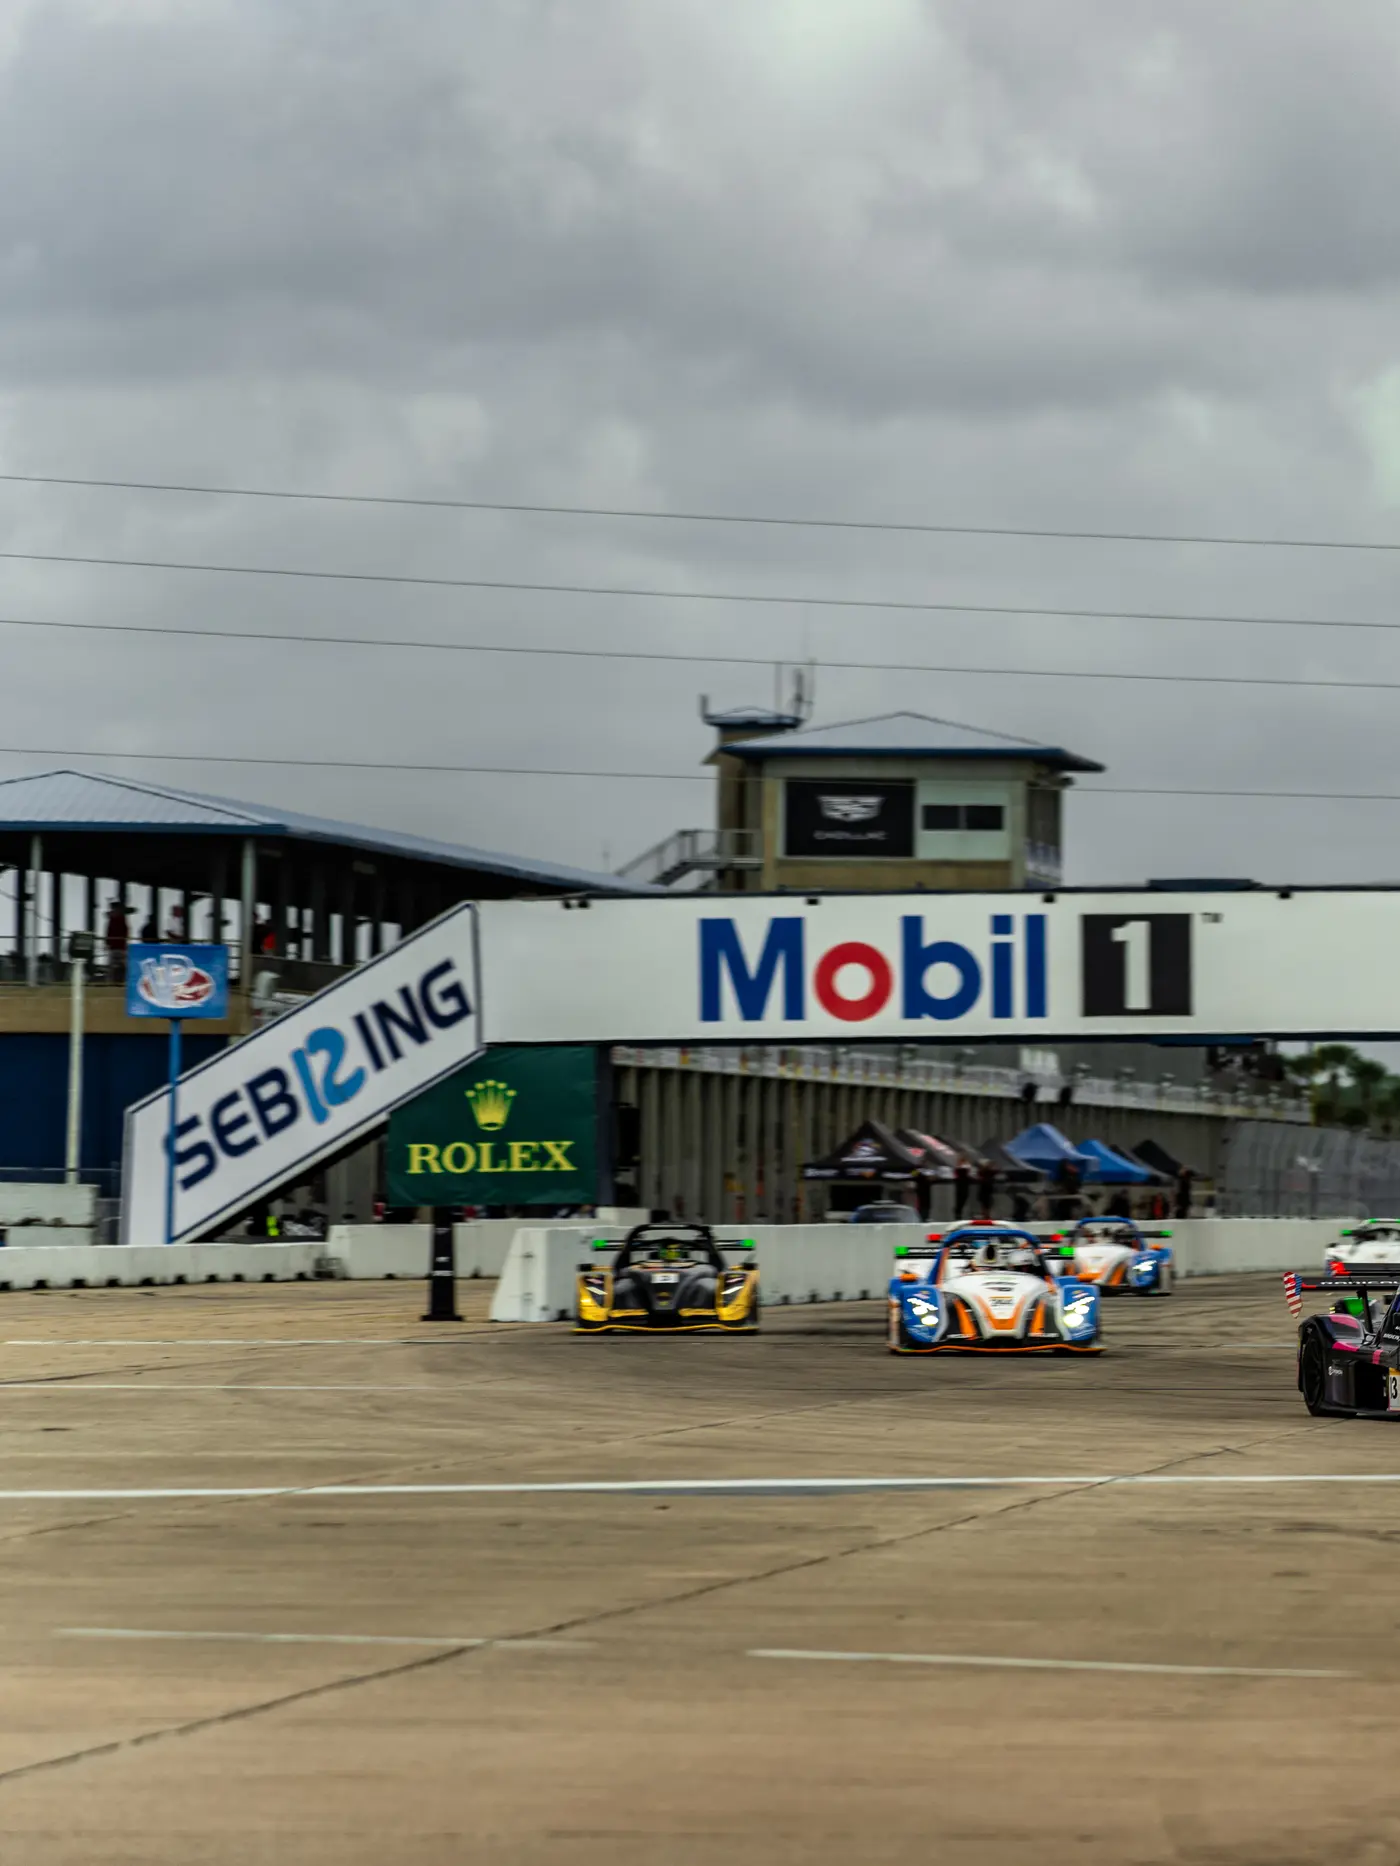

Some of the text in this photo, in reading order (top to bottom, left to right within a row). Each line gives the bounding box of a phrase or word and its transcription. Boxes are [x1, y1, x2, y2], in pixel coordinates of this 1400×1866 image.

[699, 914, 1047, 1022] Mobil
[1111, 920, 1150, 1010] 1
[405, 1141, 578, 1174] ROLEX
